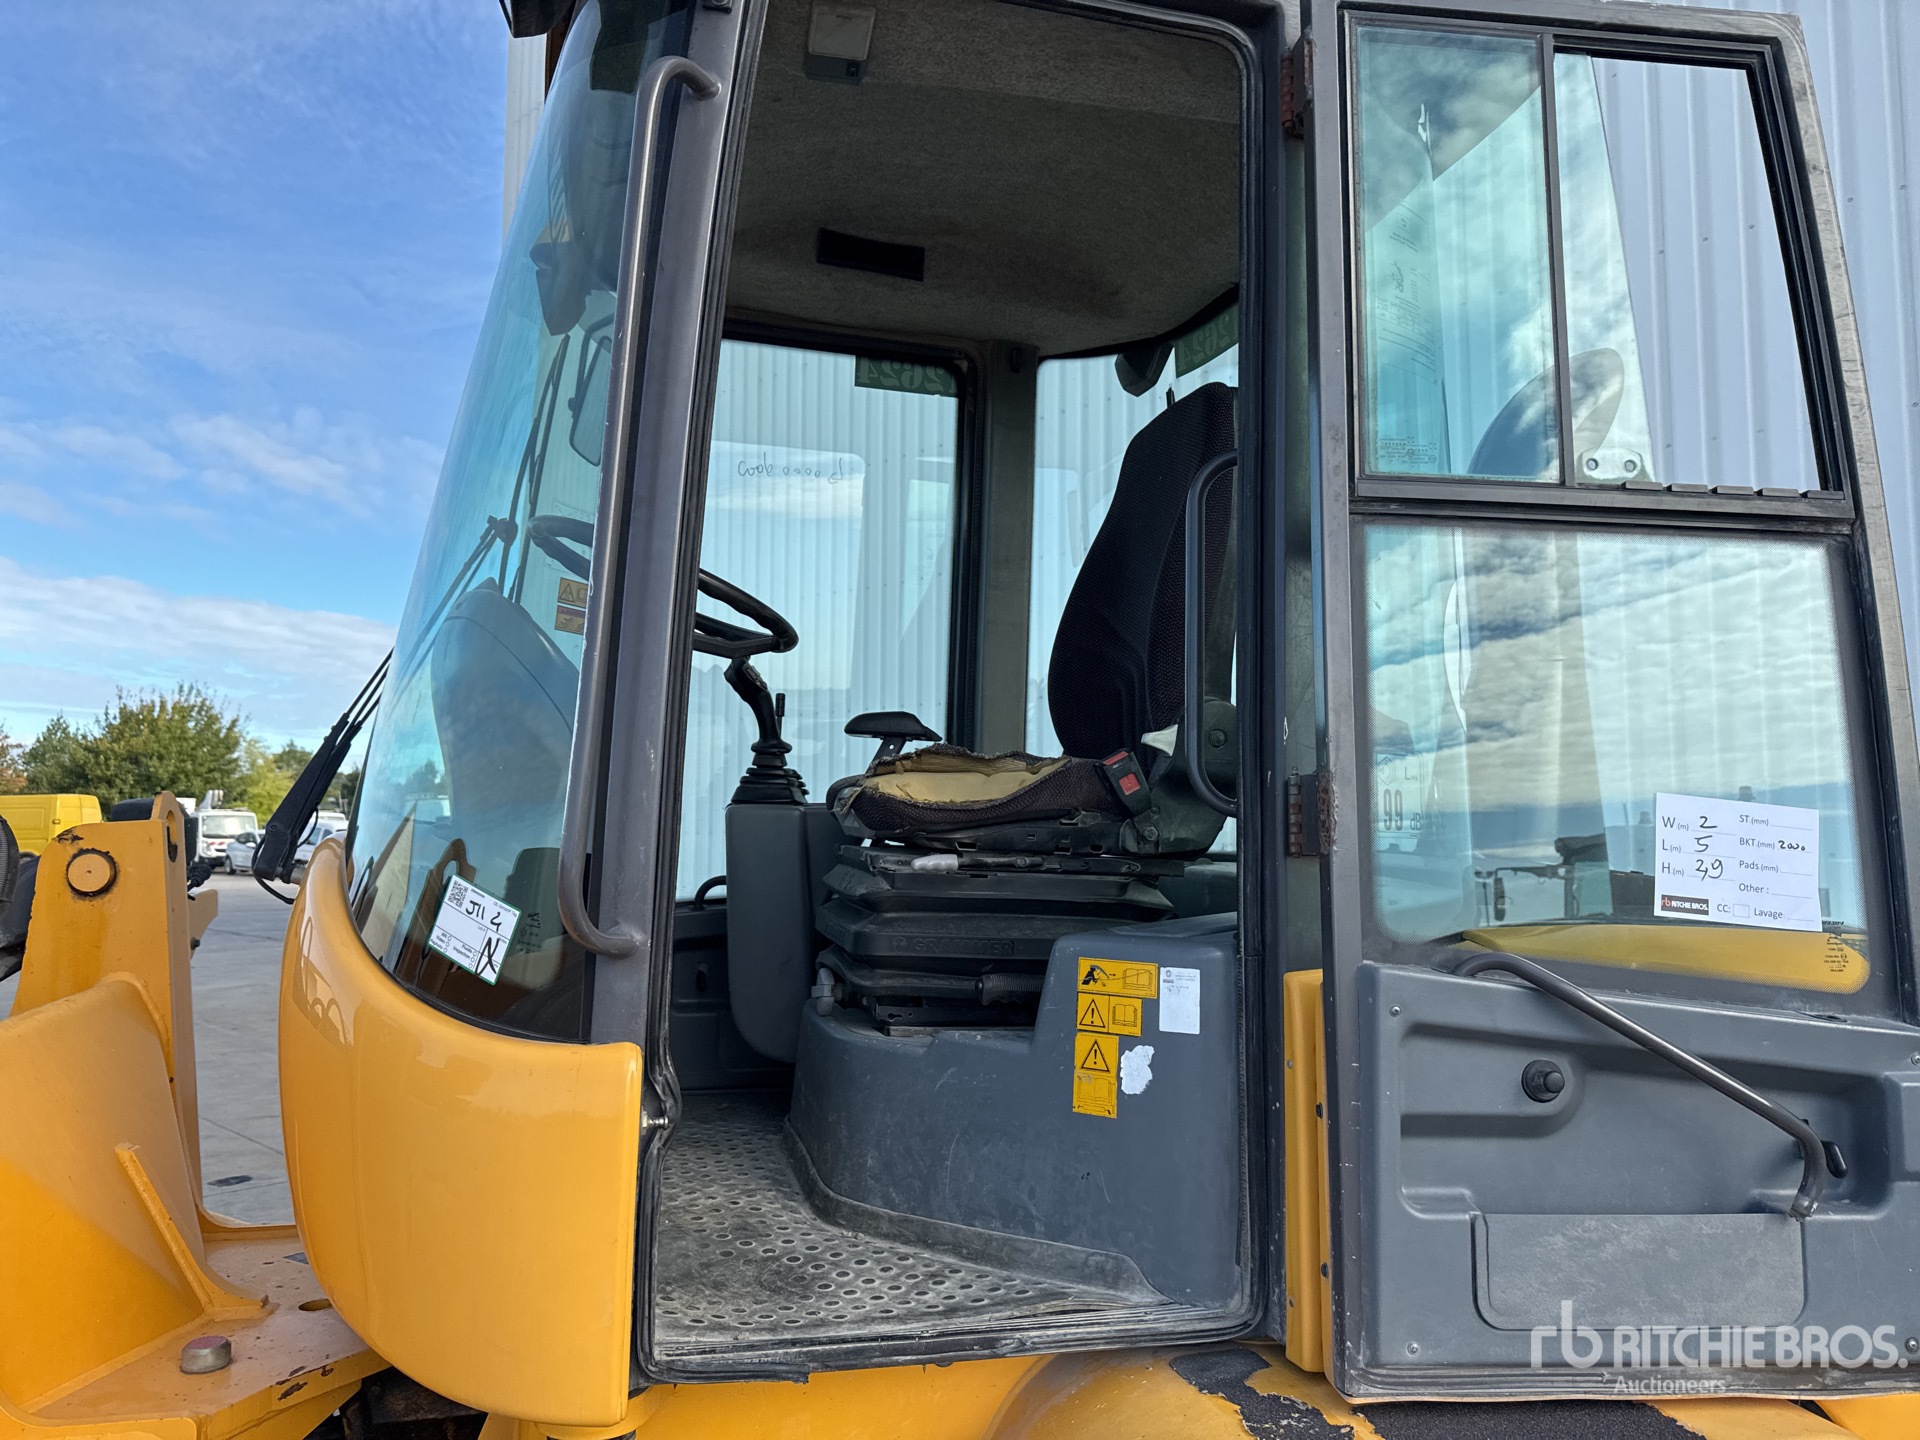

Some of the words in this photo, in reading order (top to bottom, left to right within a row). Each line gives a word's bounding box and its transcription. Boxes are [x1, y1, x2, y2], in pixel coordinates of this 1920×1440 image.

[1383, 788, 1403, 831] 99
[1409, 812, 1421, 831] dB
[1699, 816, 1718, 829] 2
[1694, 835, 1713, 852] 5
[1739, 883, 1765, 893] Other
[912, 937, 1015, 956] GRAMMER
